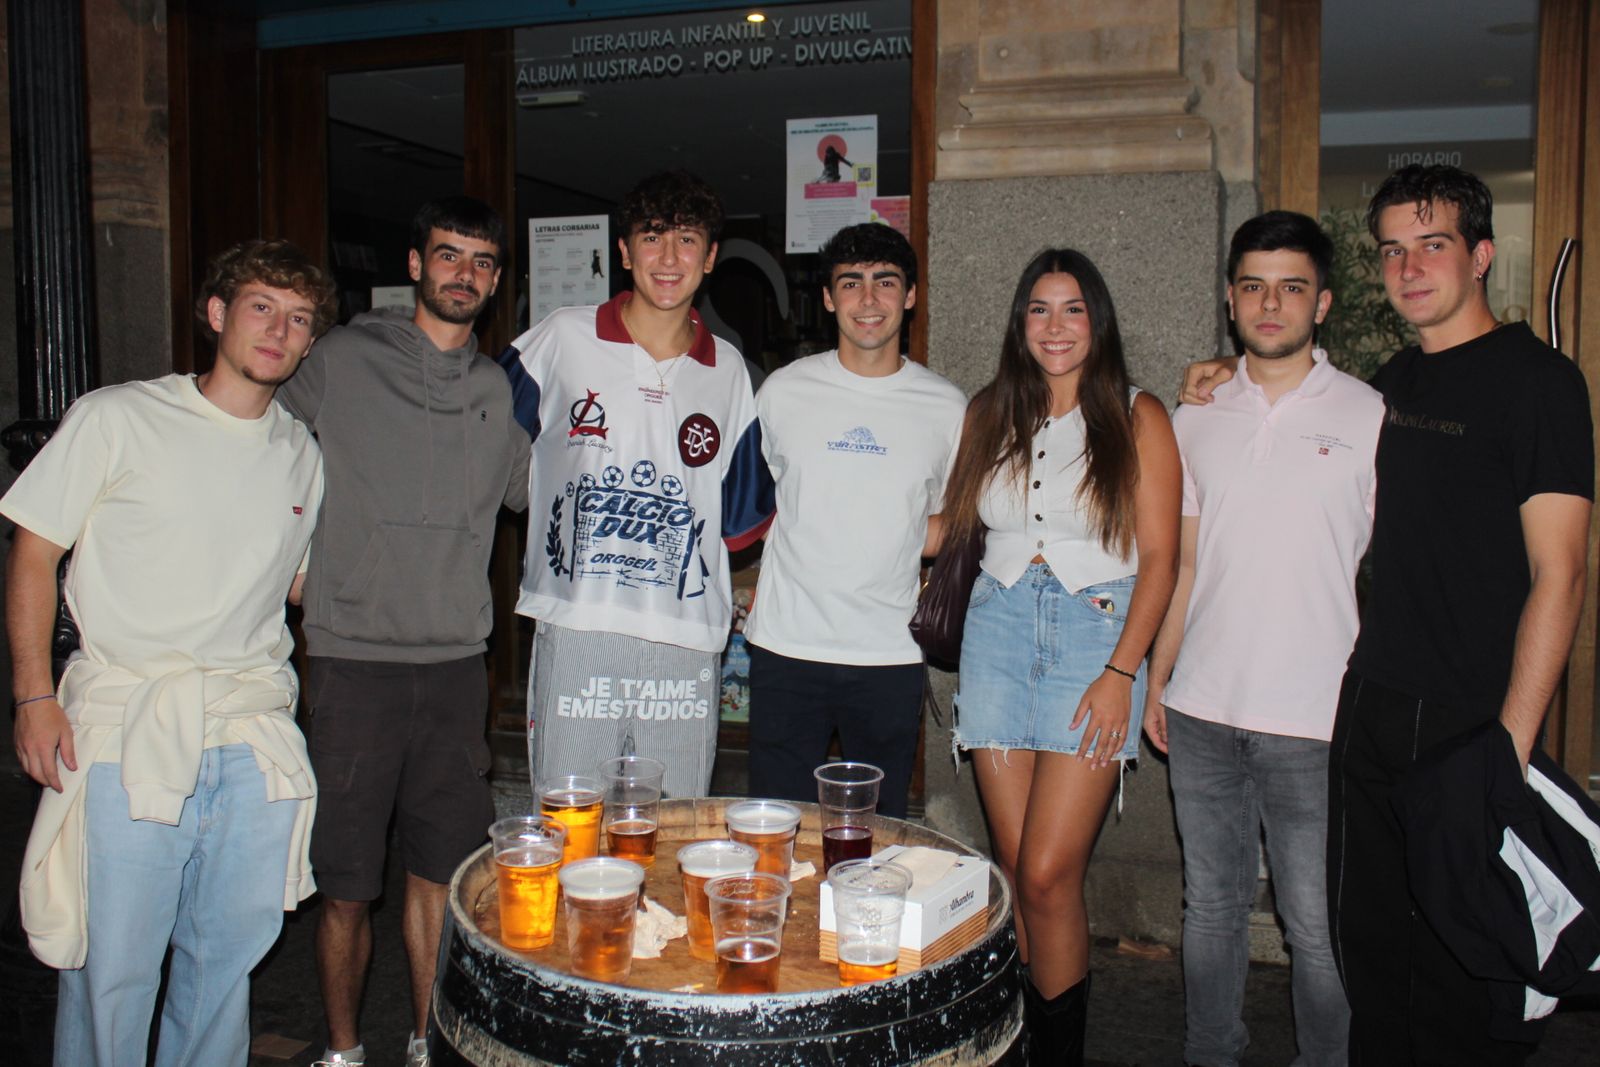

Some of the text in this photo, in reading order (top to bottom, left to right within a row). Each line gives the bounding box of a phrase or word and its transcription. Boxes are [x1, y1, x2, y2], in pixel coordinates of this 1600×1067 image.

[572, 11, 871, 55] LITERATURA INFANTIL Y JUVENIL
[516, 59, 577, 85] ÁLBUM
[583, 53, 683, 79] ILUSTRADO
[704, 50, 743, 69] POP
[750, 47, 774, 66] UP
[1388, 151, 1462, 169] HORARIO
[562, 223, 600, 232] CORSARIAS
[579, 492, 693, 527] CALCIO
[591, 516, 667, 545] DUX
[580, 677, 697, 700] JE T'AIME
[557, 695, 709, 720] EMESTUDIOS
